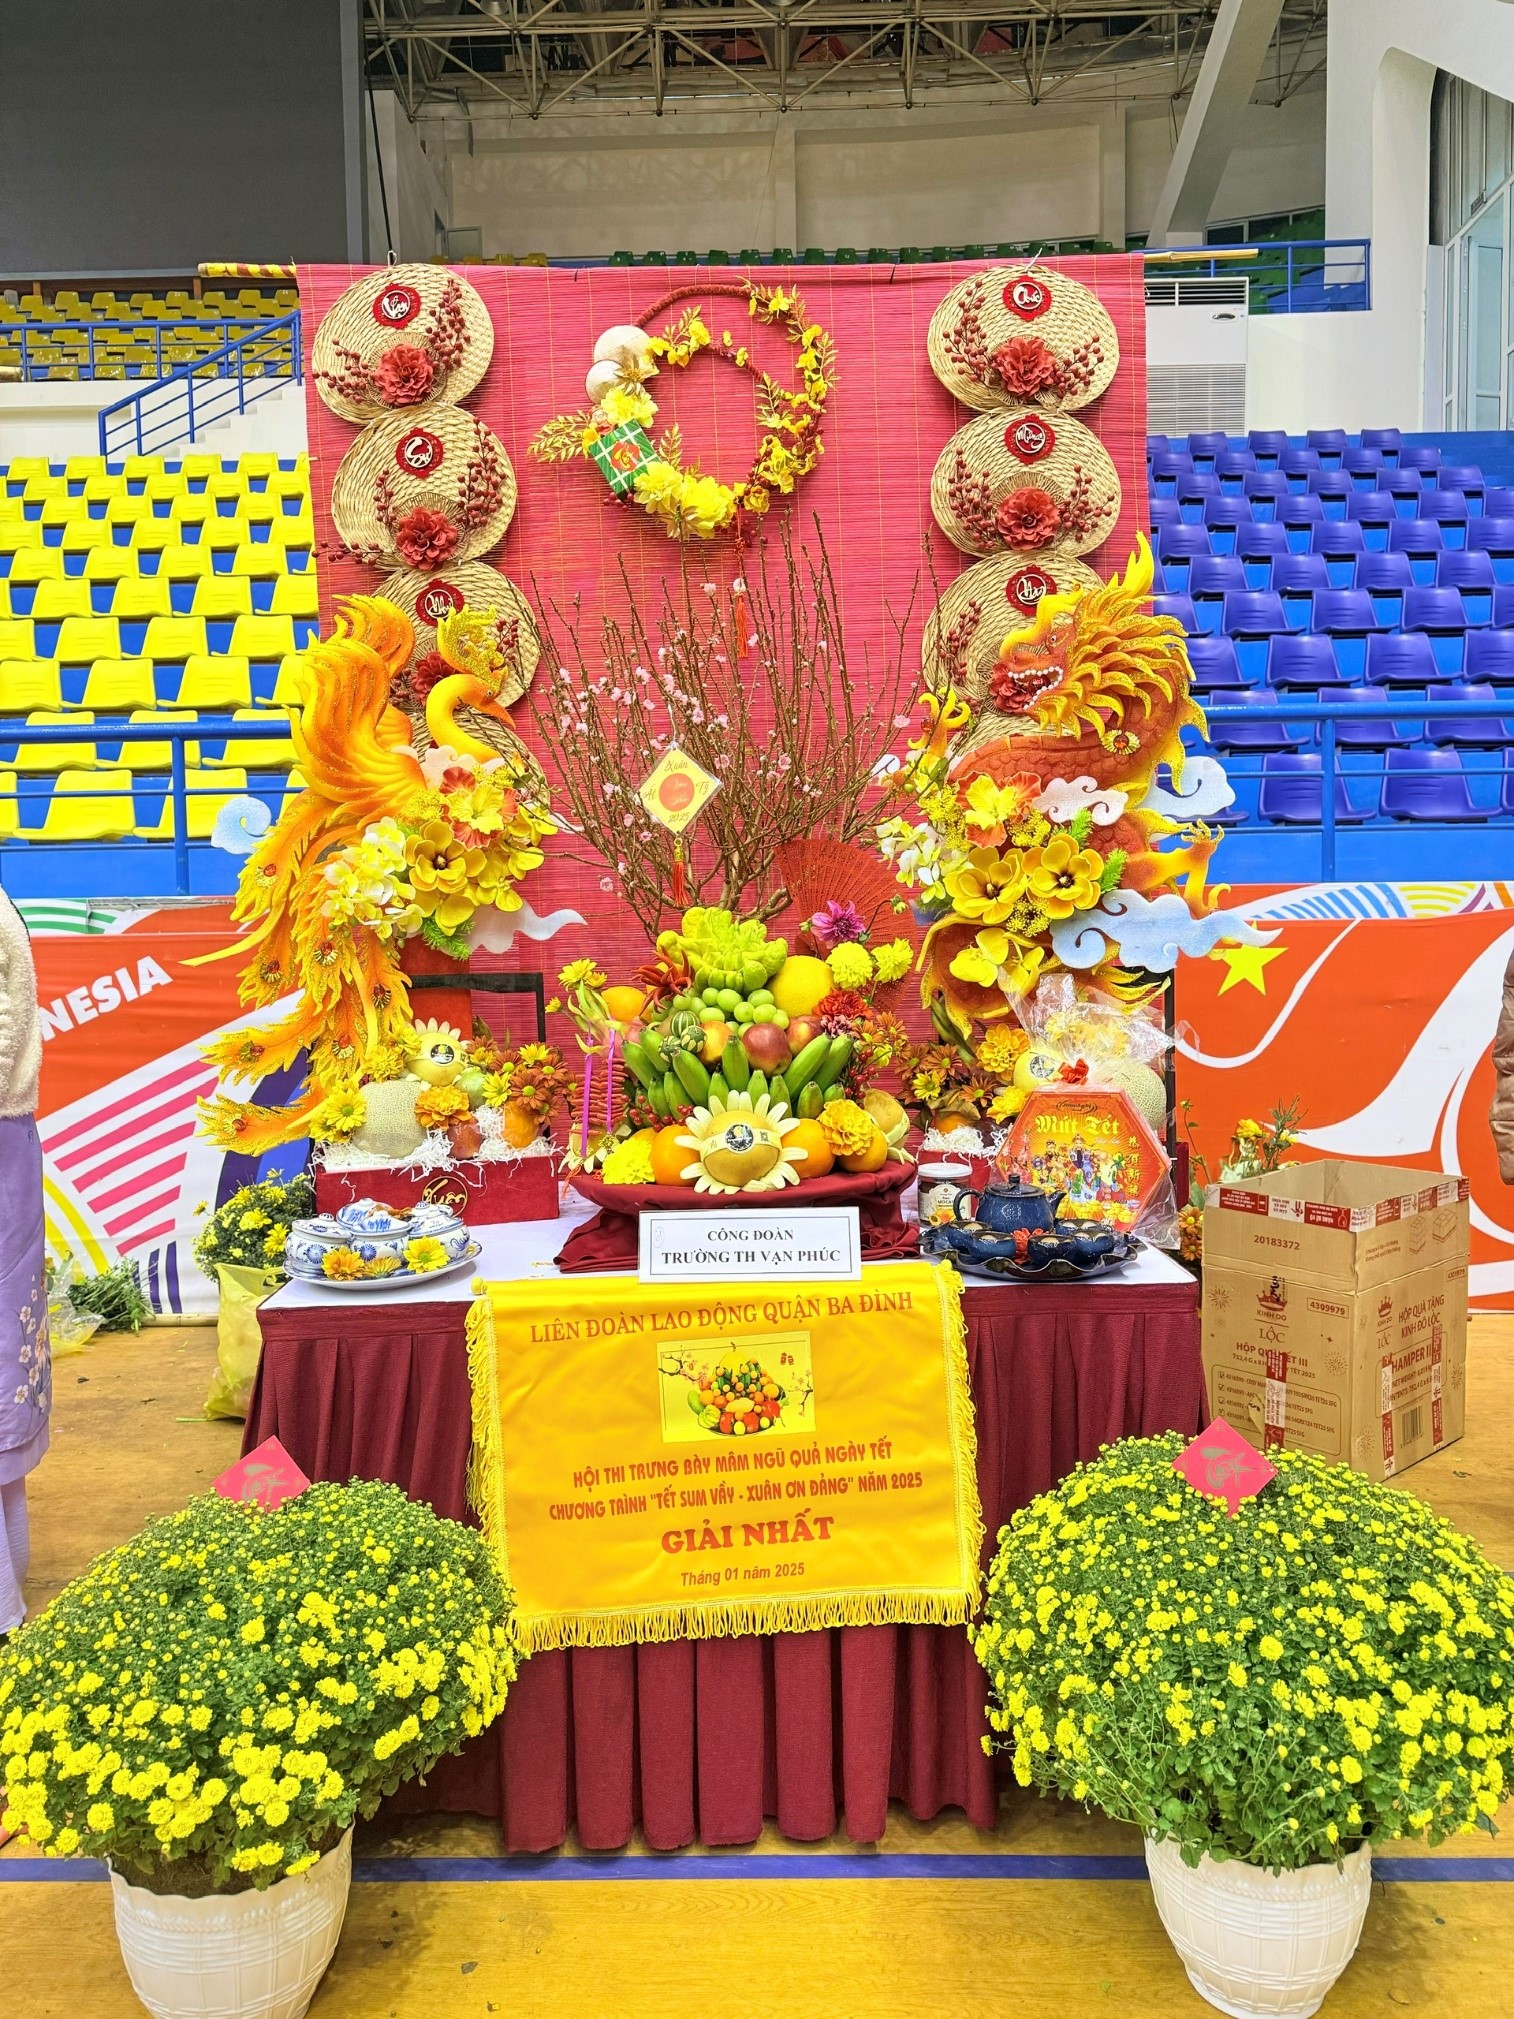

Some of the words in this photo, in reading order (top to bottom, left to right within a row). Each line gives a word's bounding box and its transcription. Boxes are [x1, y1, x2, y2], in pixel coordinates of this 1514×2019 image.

[668, 812, 690, 824] 2025
[707, 1227, 749, 1242] CÔNG
[753, 1227, 794, 1241] ĐOÀN
[1253, 1234, 1300, 1251] 20183372
[662, 1248, 730, 1264] TRƯỜNG
[733, 1250, 755, 1263] TH
[761, 1250, 793, 1266] VẠN
[797, 1247, 841, 1262] PHÚC
[530, 1319, 580, 1343] LIÊN
[586, 1312, 644, 1338] ĐOÀN
[651, 1310, 692, 1331] LAO
[697, 1302, 757, 1330] ĐỘNG
[763, 1295, 820, 1324] QUẬN
[828, 1296, 855, 1316] BA
[859, 1288, 913, 1313] ĐÌNH
[1256, 1309, 1275, 1320] KINH
[1310, 1299, 1346, 1316] 4309979
[1398, 1306, 1412, 1323] HỘP
[1259, 1326, 1285, 1344] LỘC
[1401, 1320, 1416, 1338] KINH
[1236, 1342, 1256, 1356] HỘP
[1392, 1348, 1426, 1374] HAMPER
[573, 1466, 600, 1492] HỘI
[604, 1465, 625, 1484] THI
[628, 1460, 679, 1480] TRƯNG
[683, 1454, 711, 1475] BÀY
[716, 1451, 750, 1473] MÂM
[753, 1448, 785, 1471] NGŨ
[789, 1442, 821, 1468] QUẢ
[825, 1441, 866, 1463] NGÀY
[869, 1435, 892, 1460] TẾT
[549, 1500, 606, 1521] CHƯƠNG
[609, 1493, 647, 1516] TRÌNH
[650, 1484, 676, 1510] "TẾT
[680, 1488, 706, 1508] SUM
[709, 1480, 735, 1504] VẦY
[747, 1479, 782, 1502] XUÂN
[785, 1480, 806, 1498] ƠN
[809, 1473, 854, 1497] ĐẢNG"
[858, 1471, 888, 1492] NĂM
[891, 1472, 923, 1490] 2025
[661, 1518, 734, 1554] GIẢI
[741, 1507, 834, 1547] NHẤT
[681, 1570, 721, 1586] Tháng
[724, 1568, 738, 1581] 01
[743, 1565, 771, 1580] năm
[775, 1562, 805, 1578] 2025
